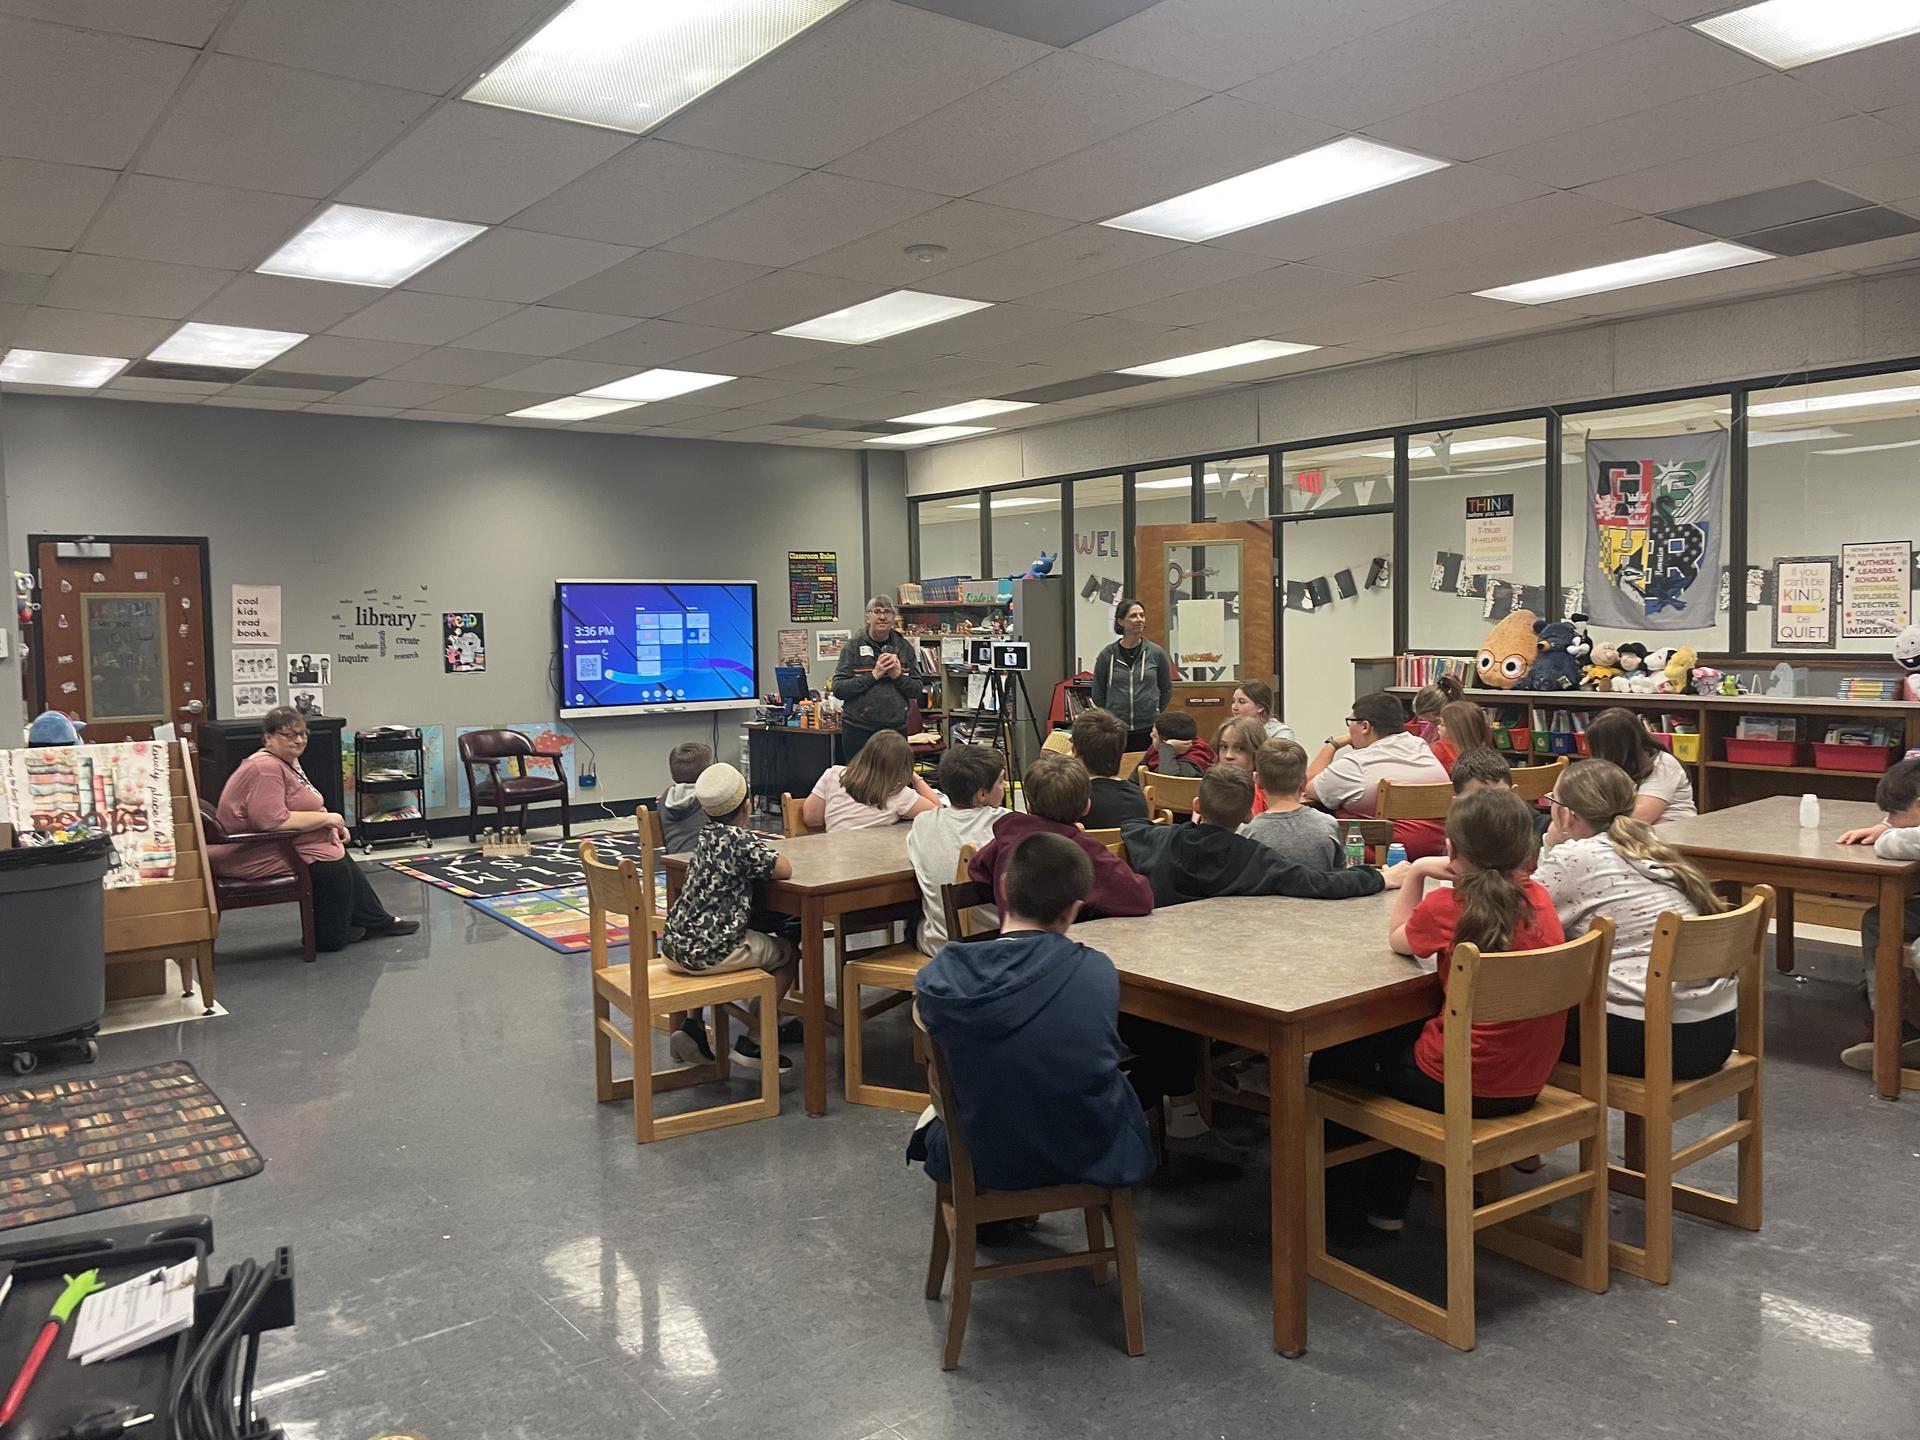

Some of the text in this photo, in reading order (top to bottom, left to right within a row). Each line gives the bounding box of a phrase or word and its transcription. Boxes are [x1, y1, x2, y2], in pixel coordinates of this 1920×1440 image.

[1783, 588, 1825, 602] KIND,
[237, 597, 259, 605] cool
[237, 608, 258, 616] kids
[237, 618, 260, 627] read
[355, 606, 417, 631] library
[237, 629, 271, 638] books.
[574, 626, 615, 637] 3:36 PM
[1781, 626, 1826, 639] QUIET.
[338, 653, 369, 664] inquire
